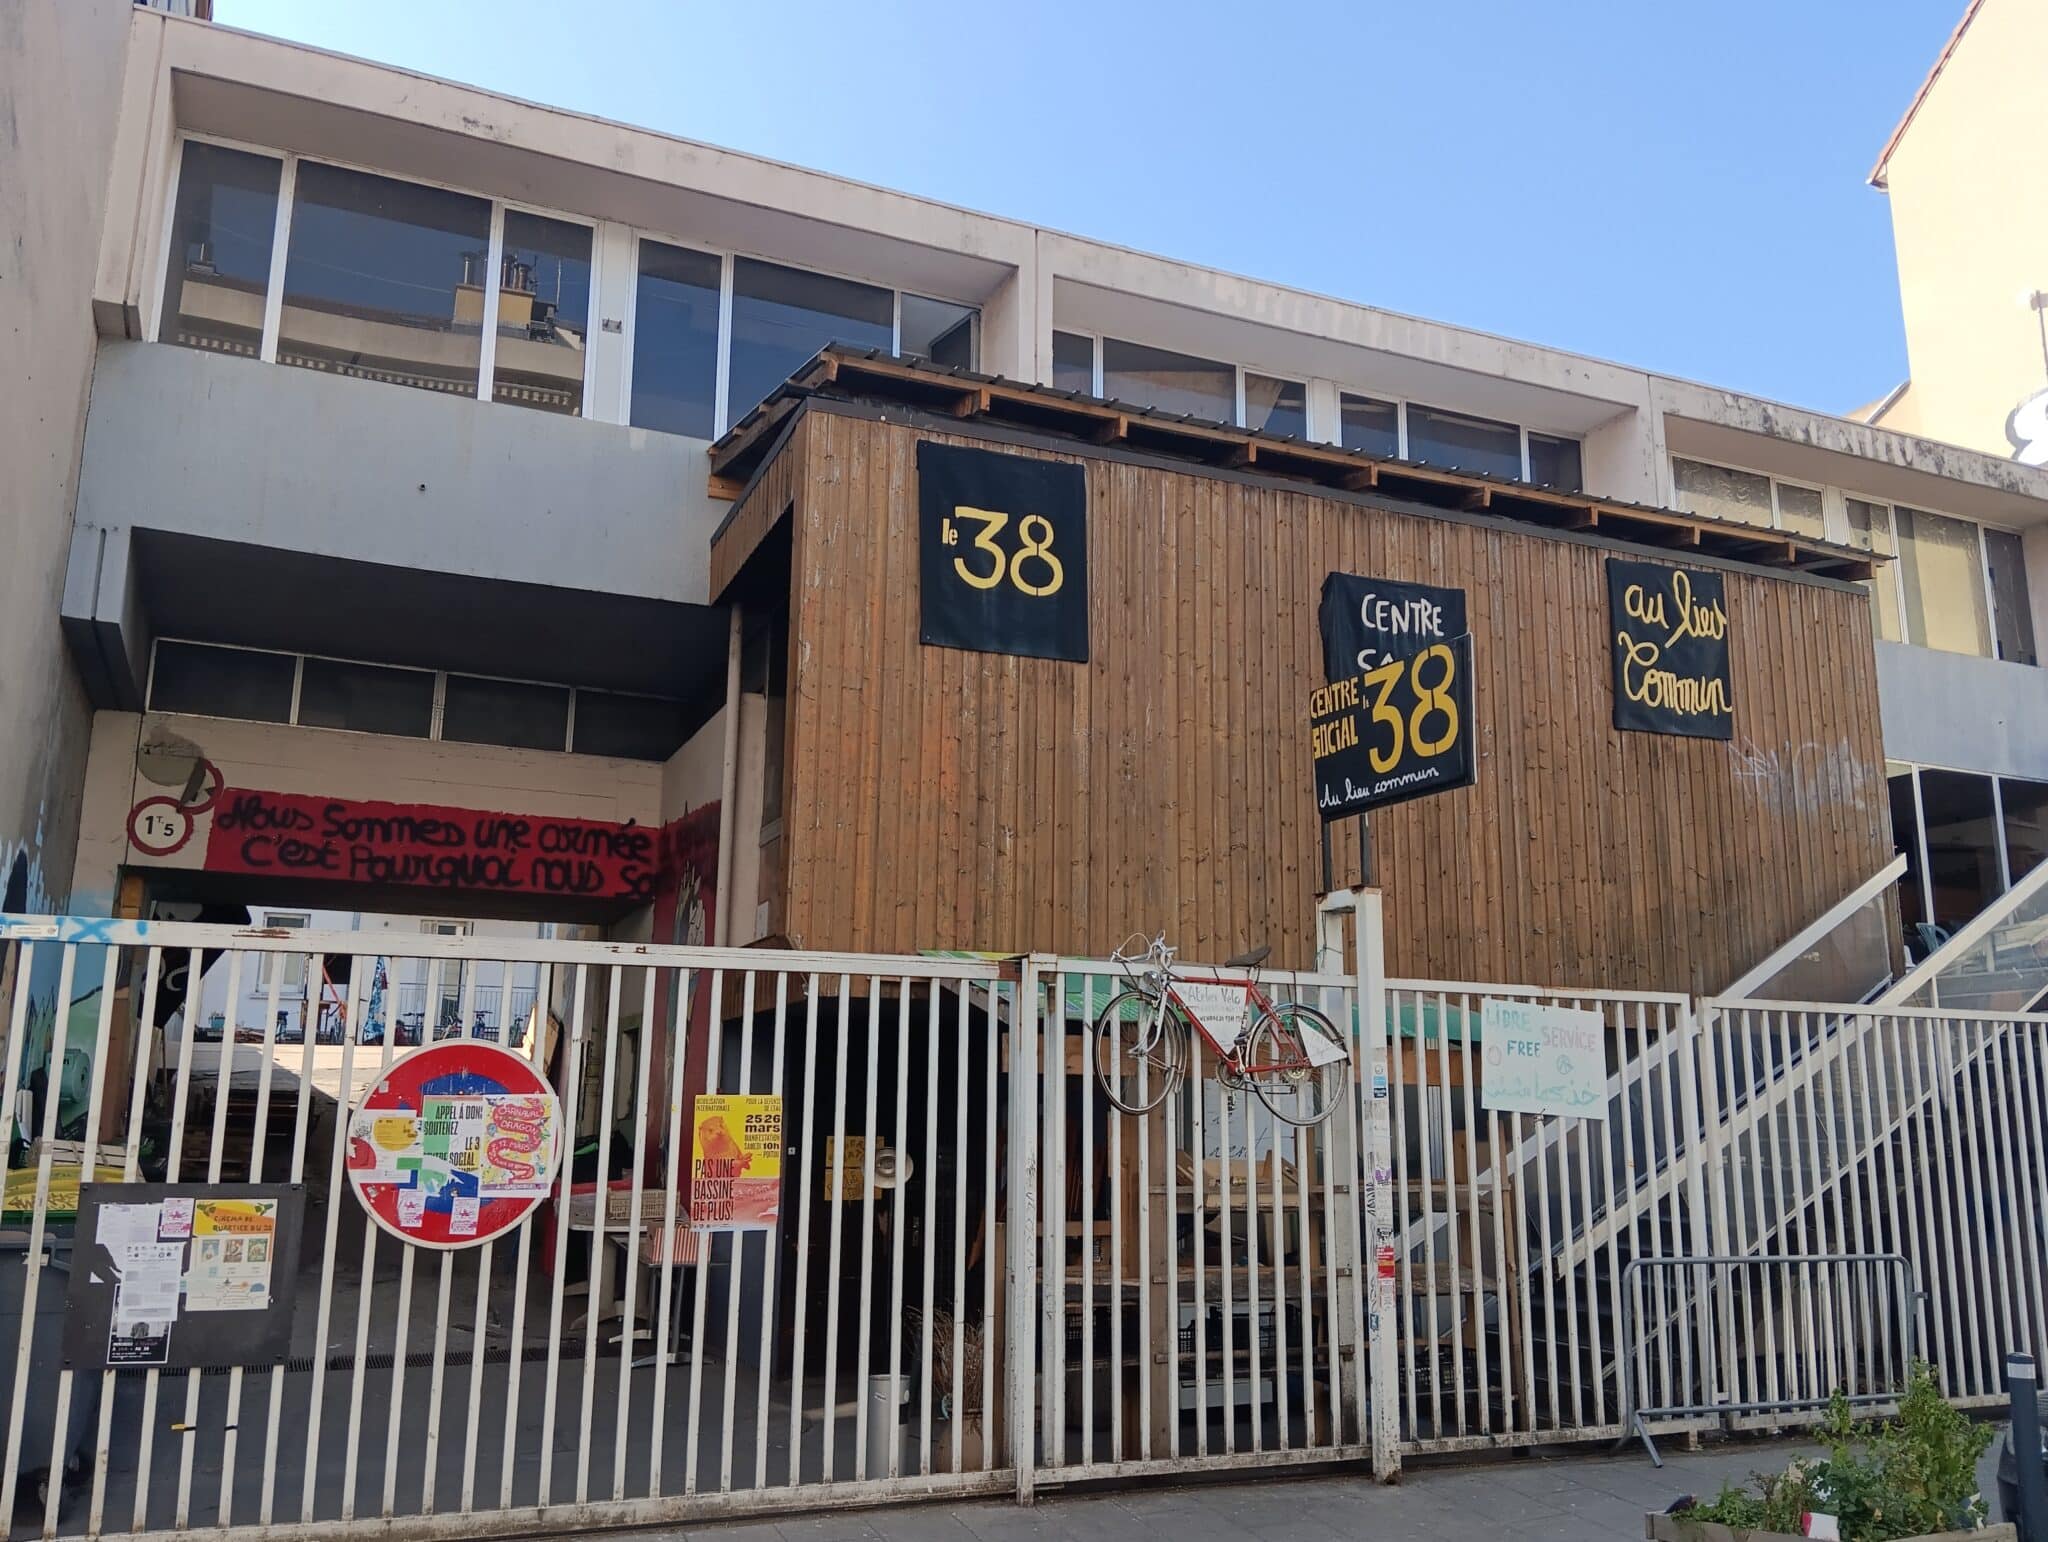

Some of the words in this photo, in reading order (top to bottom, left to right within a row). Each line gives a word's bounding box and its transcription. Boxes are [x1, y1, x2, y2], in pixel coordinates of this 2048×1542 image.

[941, 517, 959, 546] le
[953, 505, 1065, 597] 38
[1360, 593, 1445, 637] CENTRE
[1625, 584, 1670, 630] au
[1664, 570, 1728, 648] lieu
[1310, 676, 1360, 719] CENTRE
[1364, 643, 1459, 774] 38
[1345, 777, 1370, 802] lieu
[1374, 766, 1440, 794] commun
[217, 795, 314, 831] Nous
[475, 818, 531, 850] une
[1506, 1039, 1541, 1058] FREE
[435, 1105, 457, 1120] APPEL
[498, 1105, 542, 1118] CARNAVAL
[745, 1114, 763, 1124] 25
[763, 1114, 781, 1124] 26
[424, 1121, 459, 1136] SOUTENEZ
[500, 1120, 539, 1135] DRAGON
[745, 1124, 781, 1133] mars
[465, 1136, 473, 1151] LE
[763, 1142, 780, 1150] 10h
[449, 1152, 475, 1167] SOCIAL
[695, 1160, 714, 1178] PAS
[716, 1159, 735, 1178] UNE
[693, 1179, 735, 1200] BASSINE
[693, 1201, 705, 1221] DE
[707, 1200, 734, 1221] PLUS!
